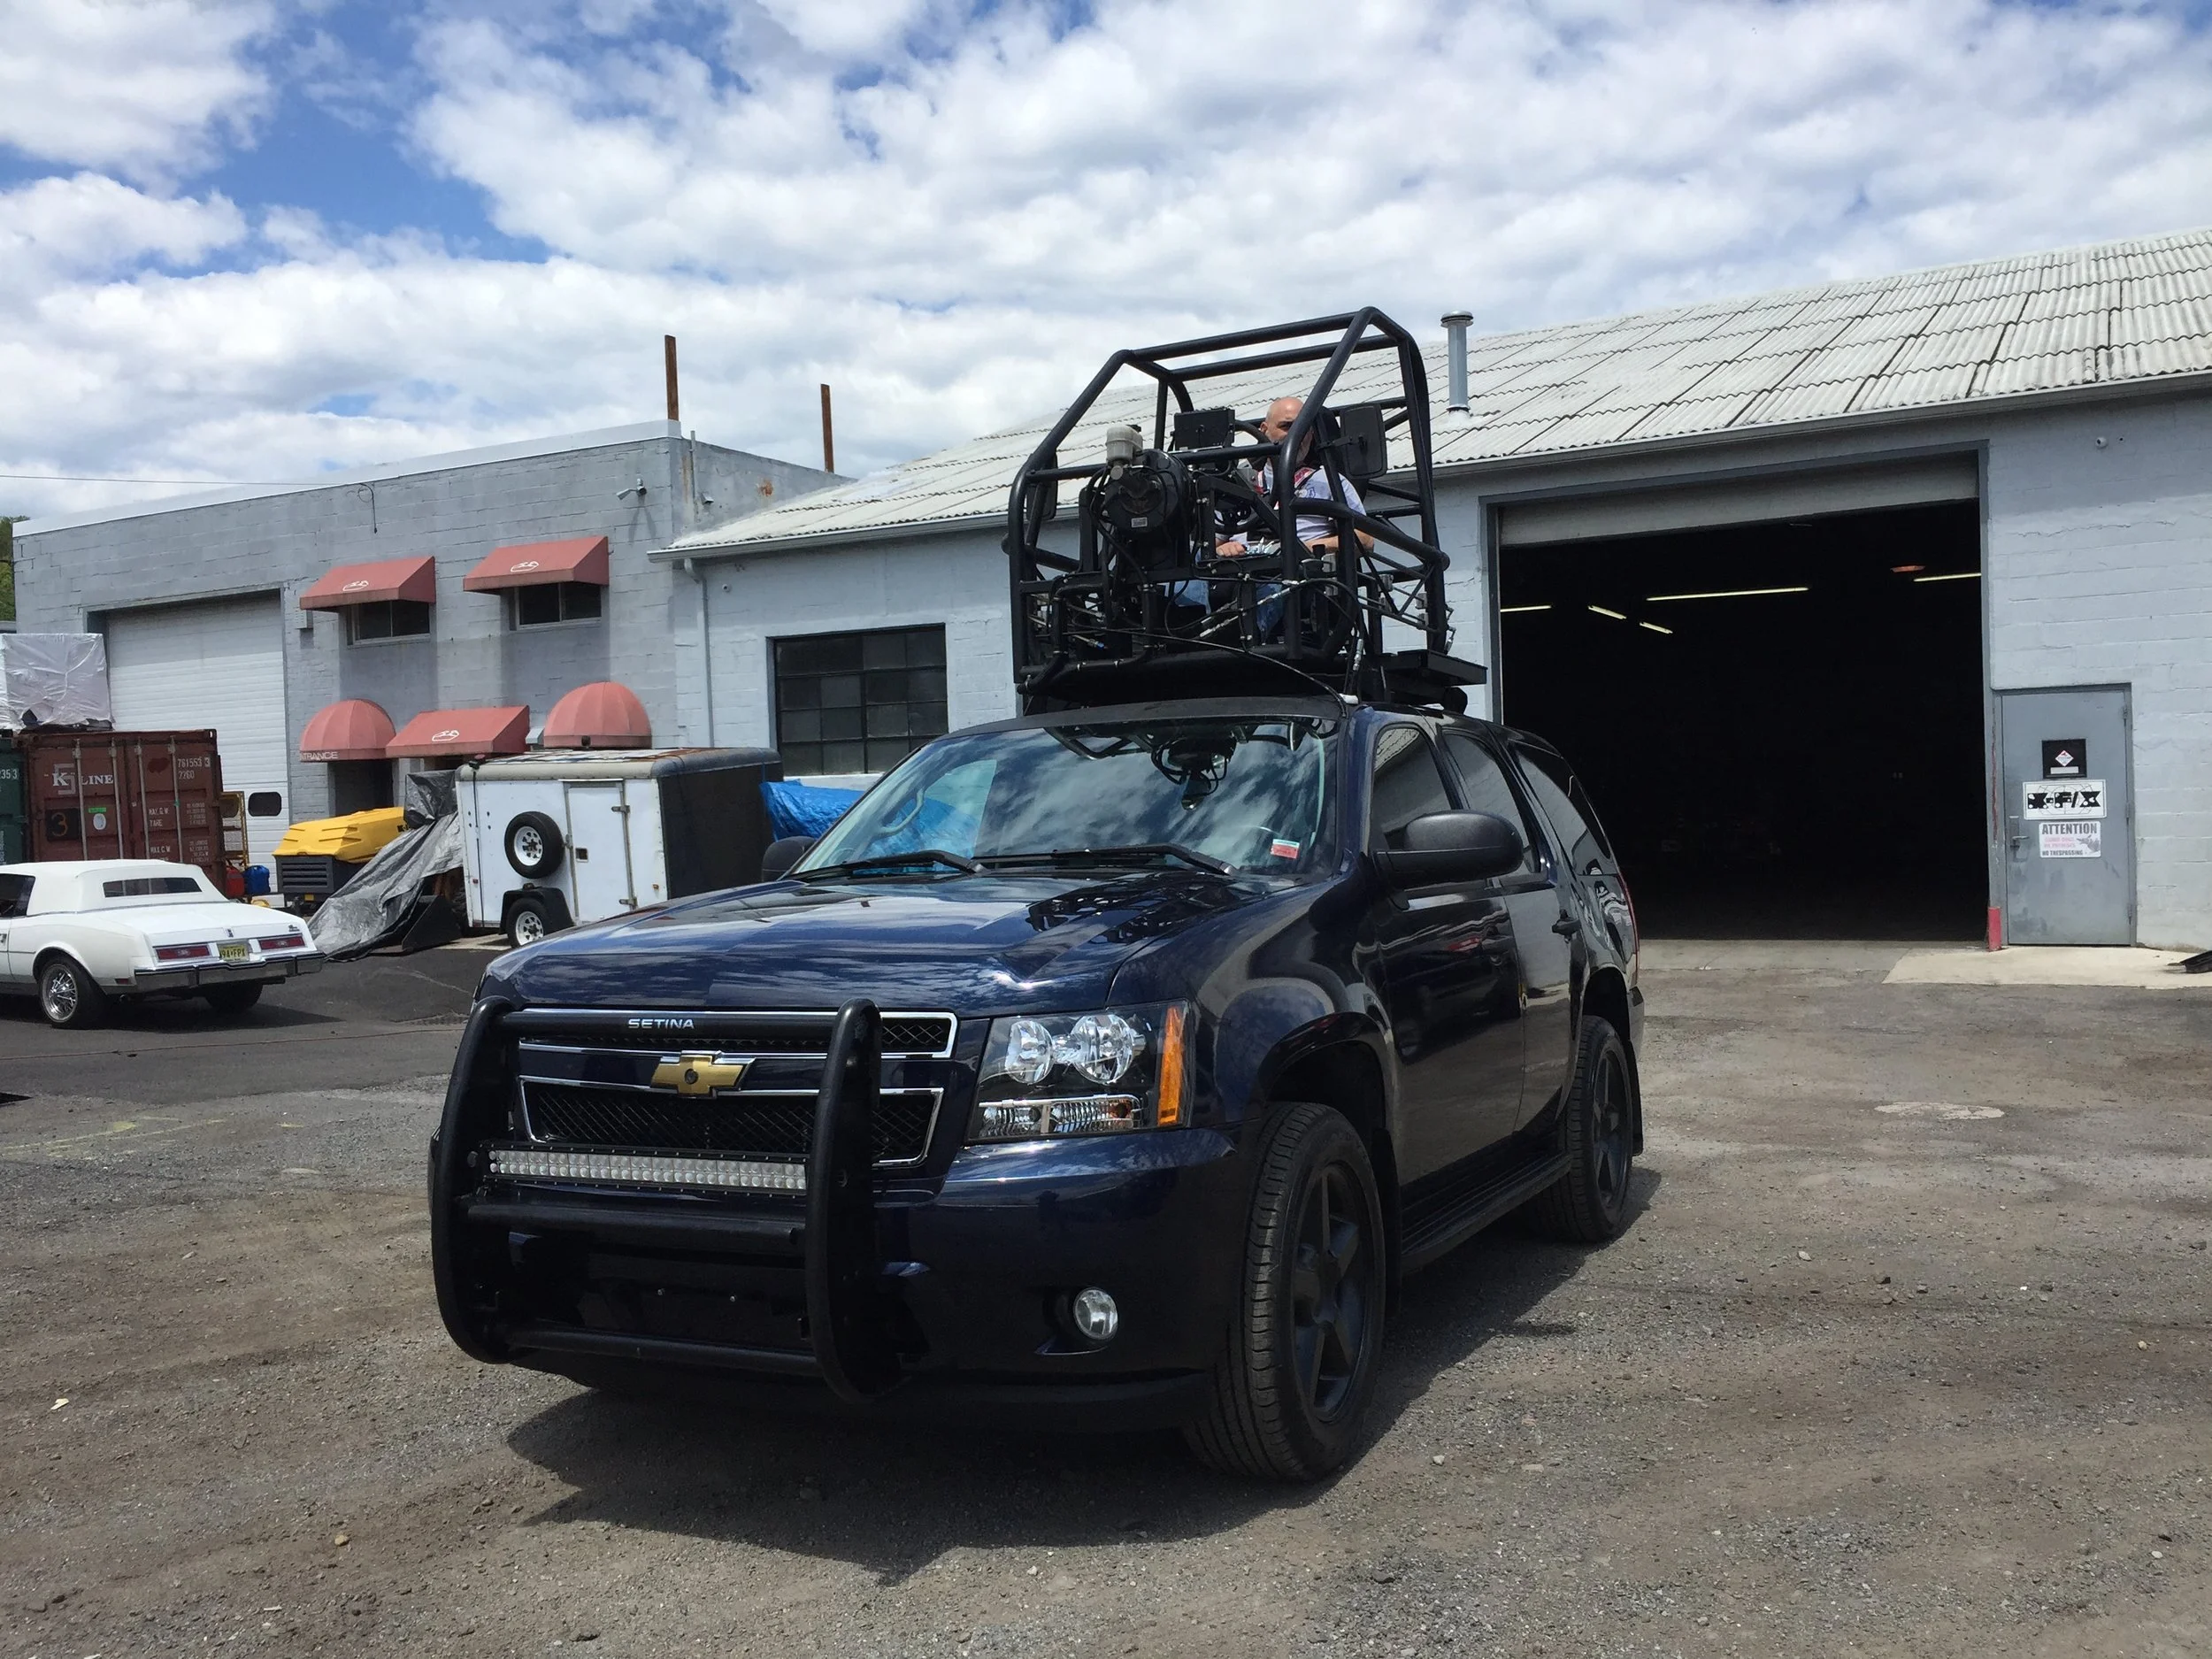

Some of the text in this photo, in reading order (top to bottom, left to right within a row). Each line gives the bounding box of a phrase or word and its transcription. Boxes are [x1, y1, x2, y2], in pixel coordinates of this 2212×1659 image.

[80, 774, 113, 786] LINE
[2041, 823, 2097, 834] ATTENTION
[628, 1018, 695, 1029] SETINA
